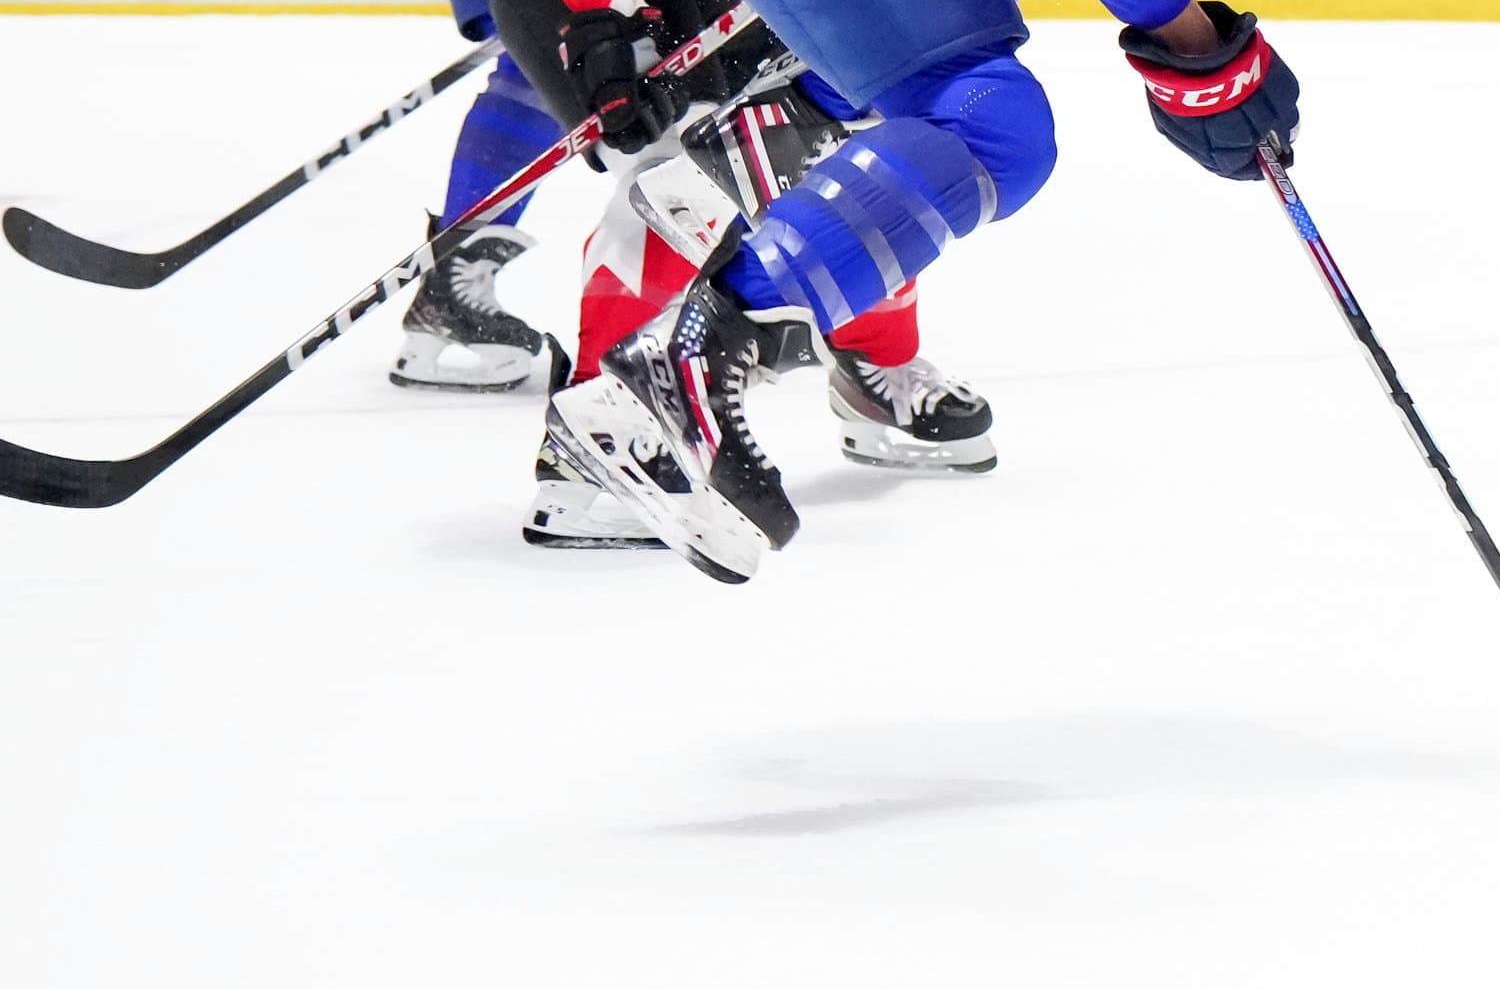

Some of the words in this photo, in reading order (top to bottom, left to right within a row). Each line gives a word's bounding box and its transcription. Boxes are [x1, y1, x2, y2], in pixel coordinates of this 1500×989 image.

[302, 79, 435, 182] CCM
[1147, 54, 1262, 108] CCM
[285, 240, 436, 372] CCM
